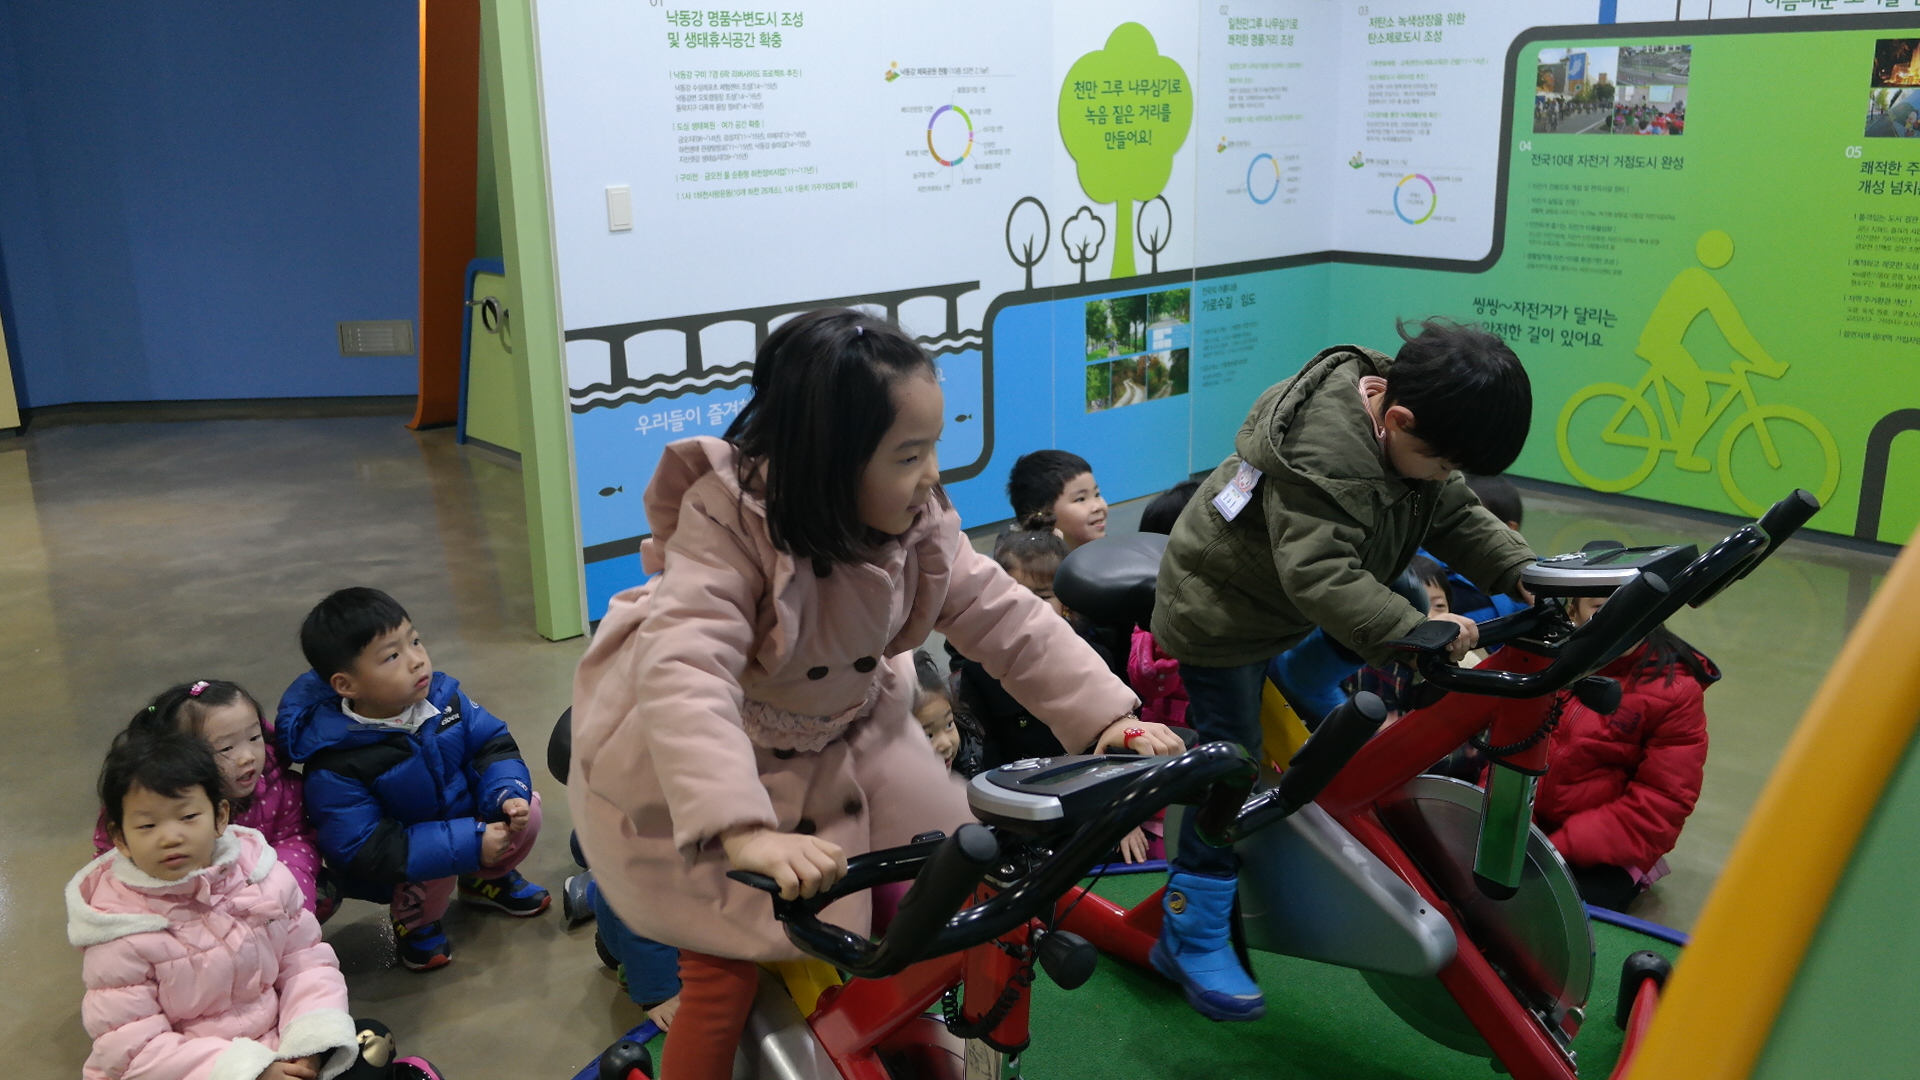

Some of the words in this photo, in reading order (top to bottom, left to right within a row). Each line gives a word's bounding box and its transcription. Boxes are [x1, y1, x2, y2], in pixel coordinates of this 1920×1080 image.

[1219, 5, 1229, 15] 02
[1358, 6, 1369, 16] 03
[666, 10, 703, 27] 낙동강
[708, 11, 777, 28] 명품수변도시
[781, 12, 804, 28] 조성
[1265, 18, 1298, 30] 나무심기로
[1368, 16, 1395, 28] 저탄소
[1398, 14, 1443, 27] 녹색성장을
[1447, 12, 1466, 26] 위한
[668, 32, 680, 48] 및
[684, 31, 755, 48] 생태휴식공간
[760, 31, 782, 48] 확충
[1228, 34, 1249, 46] 쾌적한
[1251, 34, 1278, 46] 명품거리
[1280, 34, 1294, 46] 조성
[1368, 31, 1421, 44] 탄소제로도시
[1424, 30, 1442, 43] 조성
[674, 70, 692, 79] 낙동강
[694, 70, 706, 79] 구미
[732, 70, 760, 78] 리버사이드
[762, 69, 785, 78] 프로젝트
[787, 69, 798, 78] 추진
[1074, 80, 1098, 100] 천만
[1101, 80, 1124, 97] 그루
[1129, 79, 1182, 97] 나무심기로
[1085, 105, 1108, 125] 녹음
[1112, 104, 1135, 124] 짙은
[1139, 103, 1171, 122] 거리를
[677, 122, 689, 131] 도심
[721, 120, 733, 129] 여가
[735, 120, 747, 129] 공간
[1105, 130, 1152, 150] 만들어요!
[1519, 140, 1532, 152] 04
[1846, 146, 1862, 158] 05
[1531, 154, 1574, 167] 전국10대
[1577, 154, 1609, 168] 자전거
[1614, 156, 1657, 169] 거점도시
[1661, 156, 1684, 170] 완성
[1860, 161, 1902, 176] 쾌적한
[680, 173, 698, 182] 구미천
[704, 171, 722, 181] 금오천
[1858, 180, 1885, 195] 개성
[1891, 181, 1920, 196] 넘치
[1202, 296, 1233, 312] 가로수길
[1473, 297, 1568, 320] 씽씽~자전거가
[1574, 306, 1618, 328] 달리는
[1527, 326, 1554, 344] 길이
[1560, 330, 1603, 348] 있어요
[635, 406, 700, 435] 우리들이
